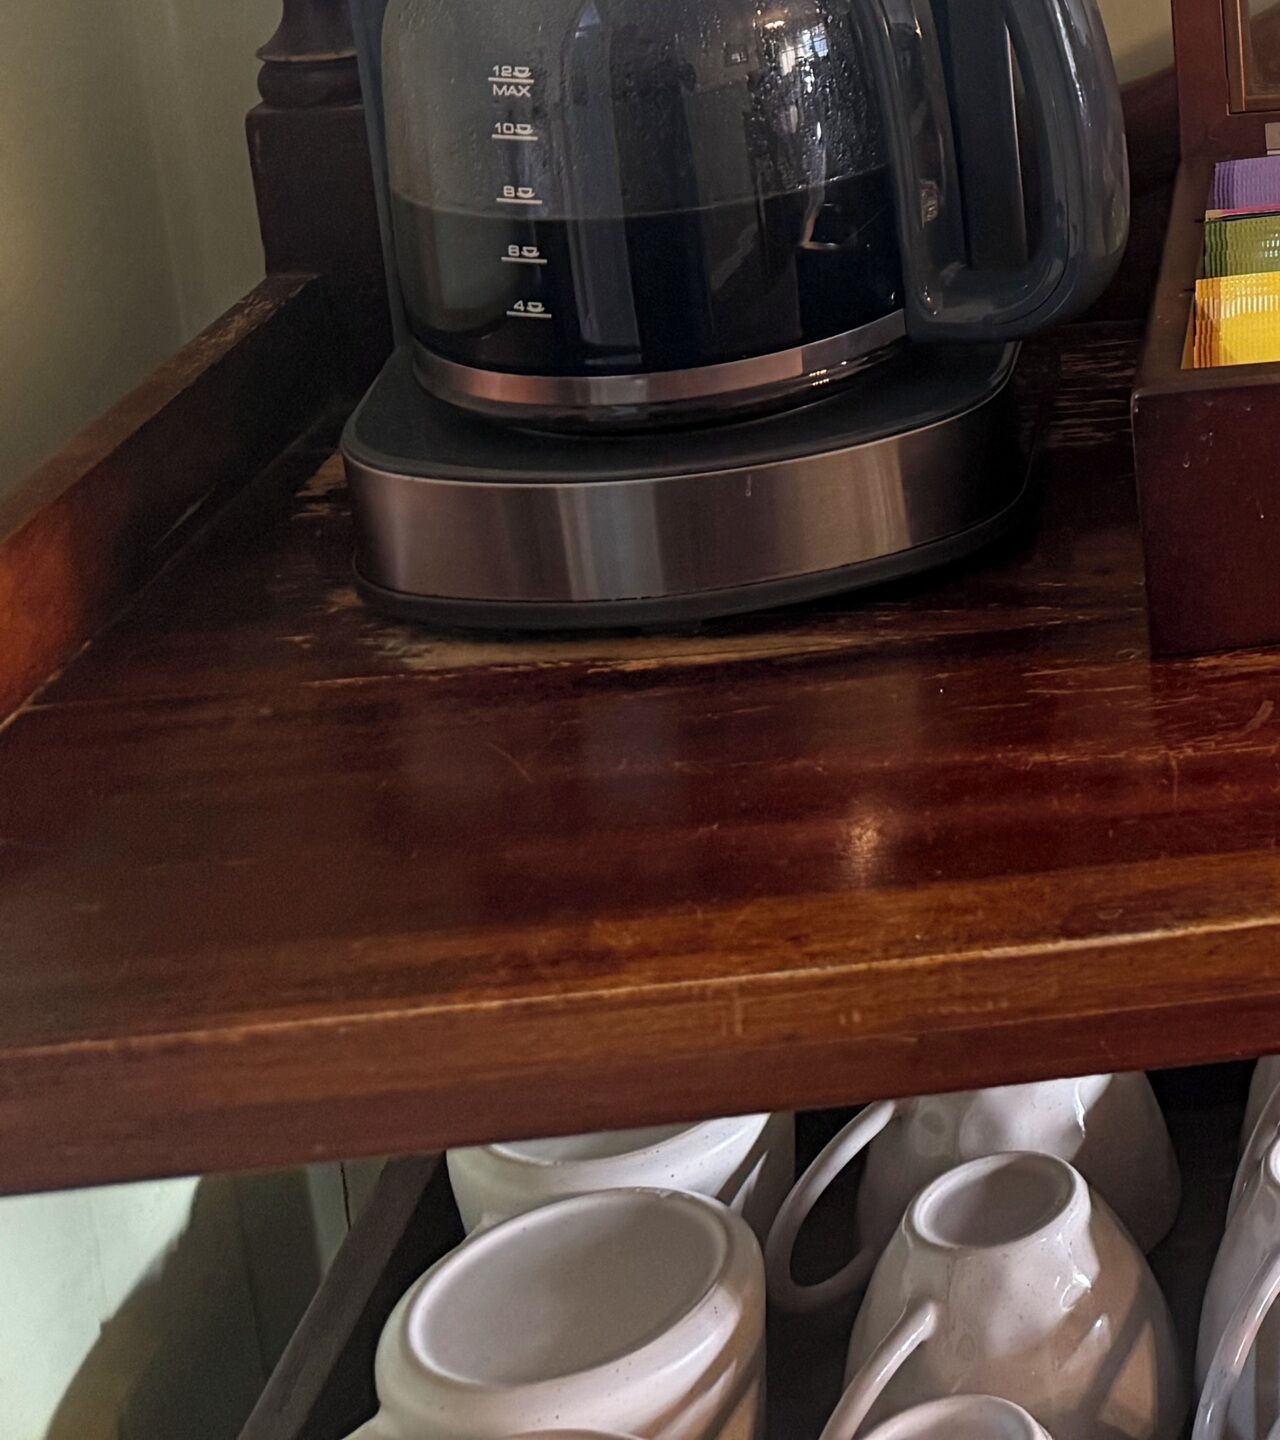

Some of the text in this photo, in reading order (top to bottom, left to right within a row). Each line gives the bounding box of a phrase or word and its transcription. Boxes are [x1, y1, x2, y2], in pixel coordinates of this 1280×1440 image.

[492, 64, 512, 78] 12
[492, 83, 532, 98] MAX
[494, 121, 514, 135] 10
[513, 299, 526, 312] 4
